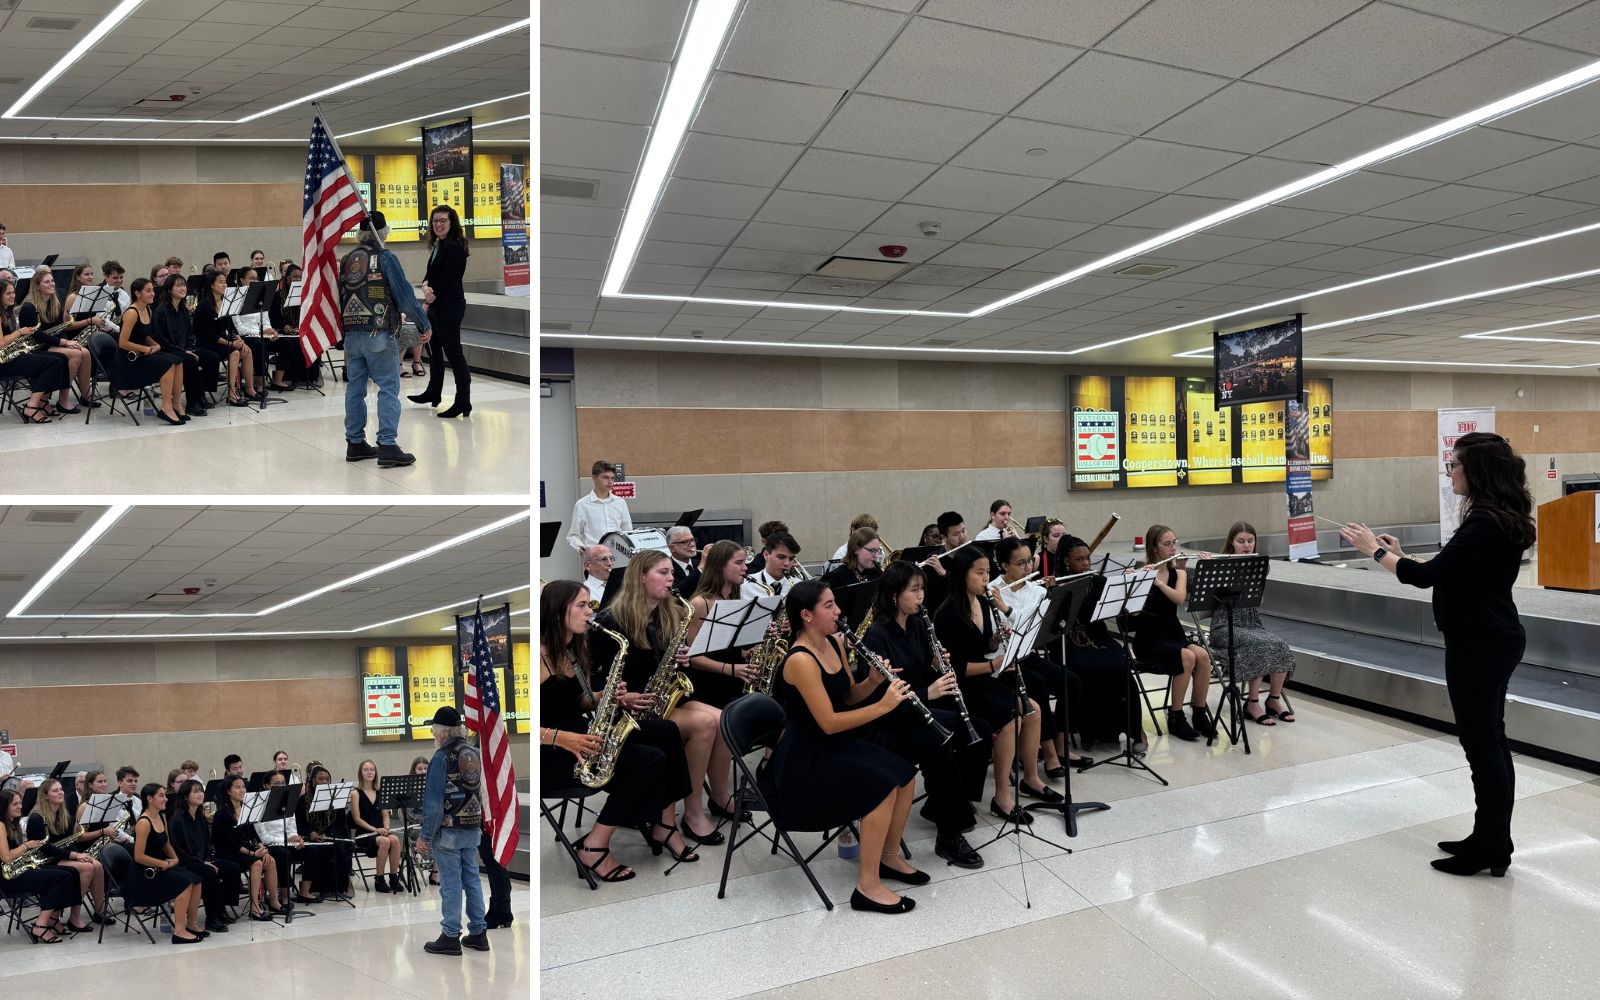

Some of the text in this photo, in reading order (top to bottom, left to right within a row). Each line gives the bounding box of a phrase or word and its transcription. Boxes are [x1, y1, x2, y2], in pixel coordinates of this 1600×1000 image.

[1193, 456, 1224, 467] Where
[1226, 453, 1264, 466] baseball
[1310, 452, 1330, 463] live.
